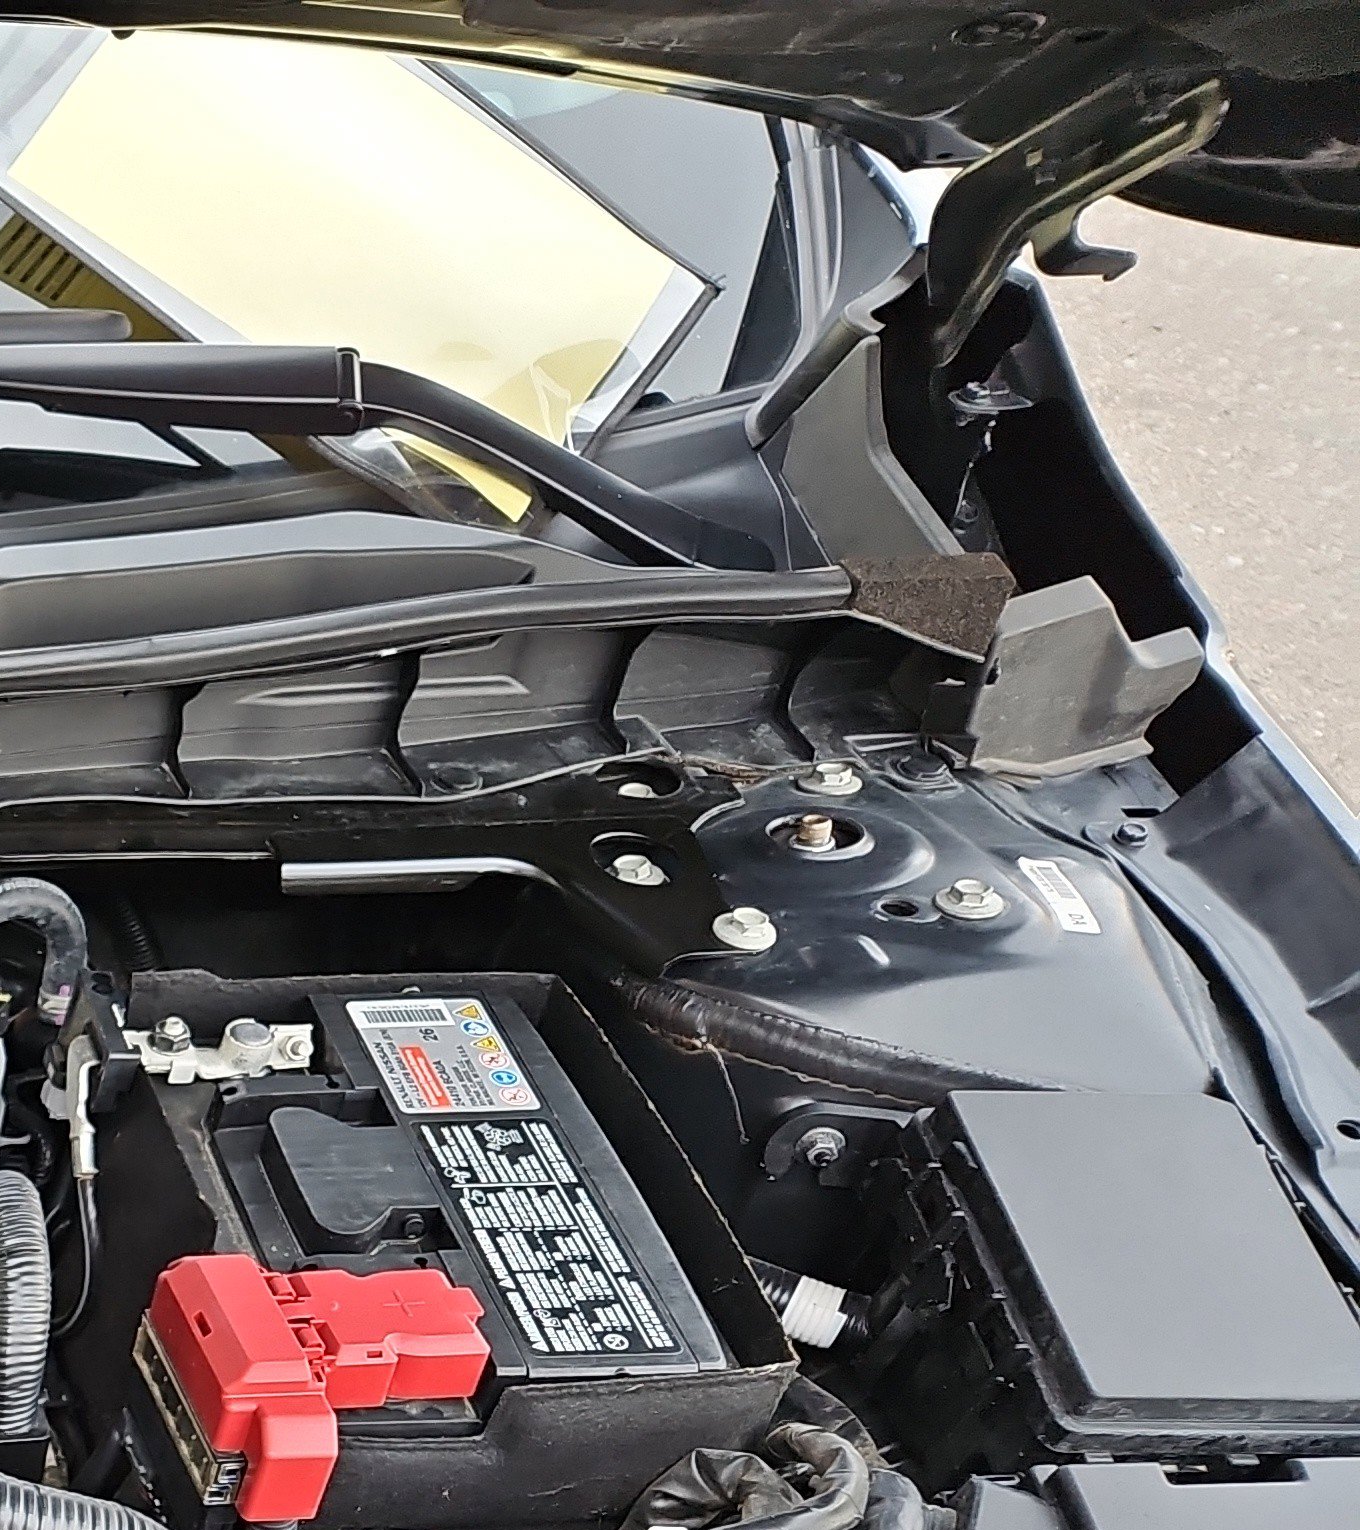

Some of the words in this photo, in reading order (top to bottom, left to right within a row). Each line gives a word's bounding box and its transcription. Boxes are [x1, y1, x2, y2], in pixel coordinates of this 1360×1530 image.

[419, 1028, 438, 1041] 26
[373, 1042, 396, 1074] NISSAN
[391, 1076, 414, 1108] RENAULT
